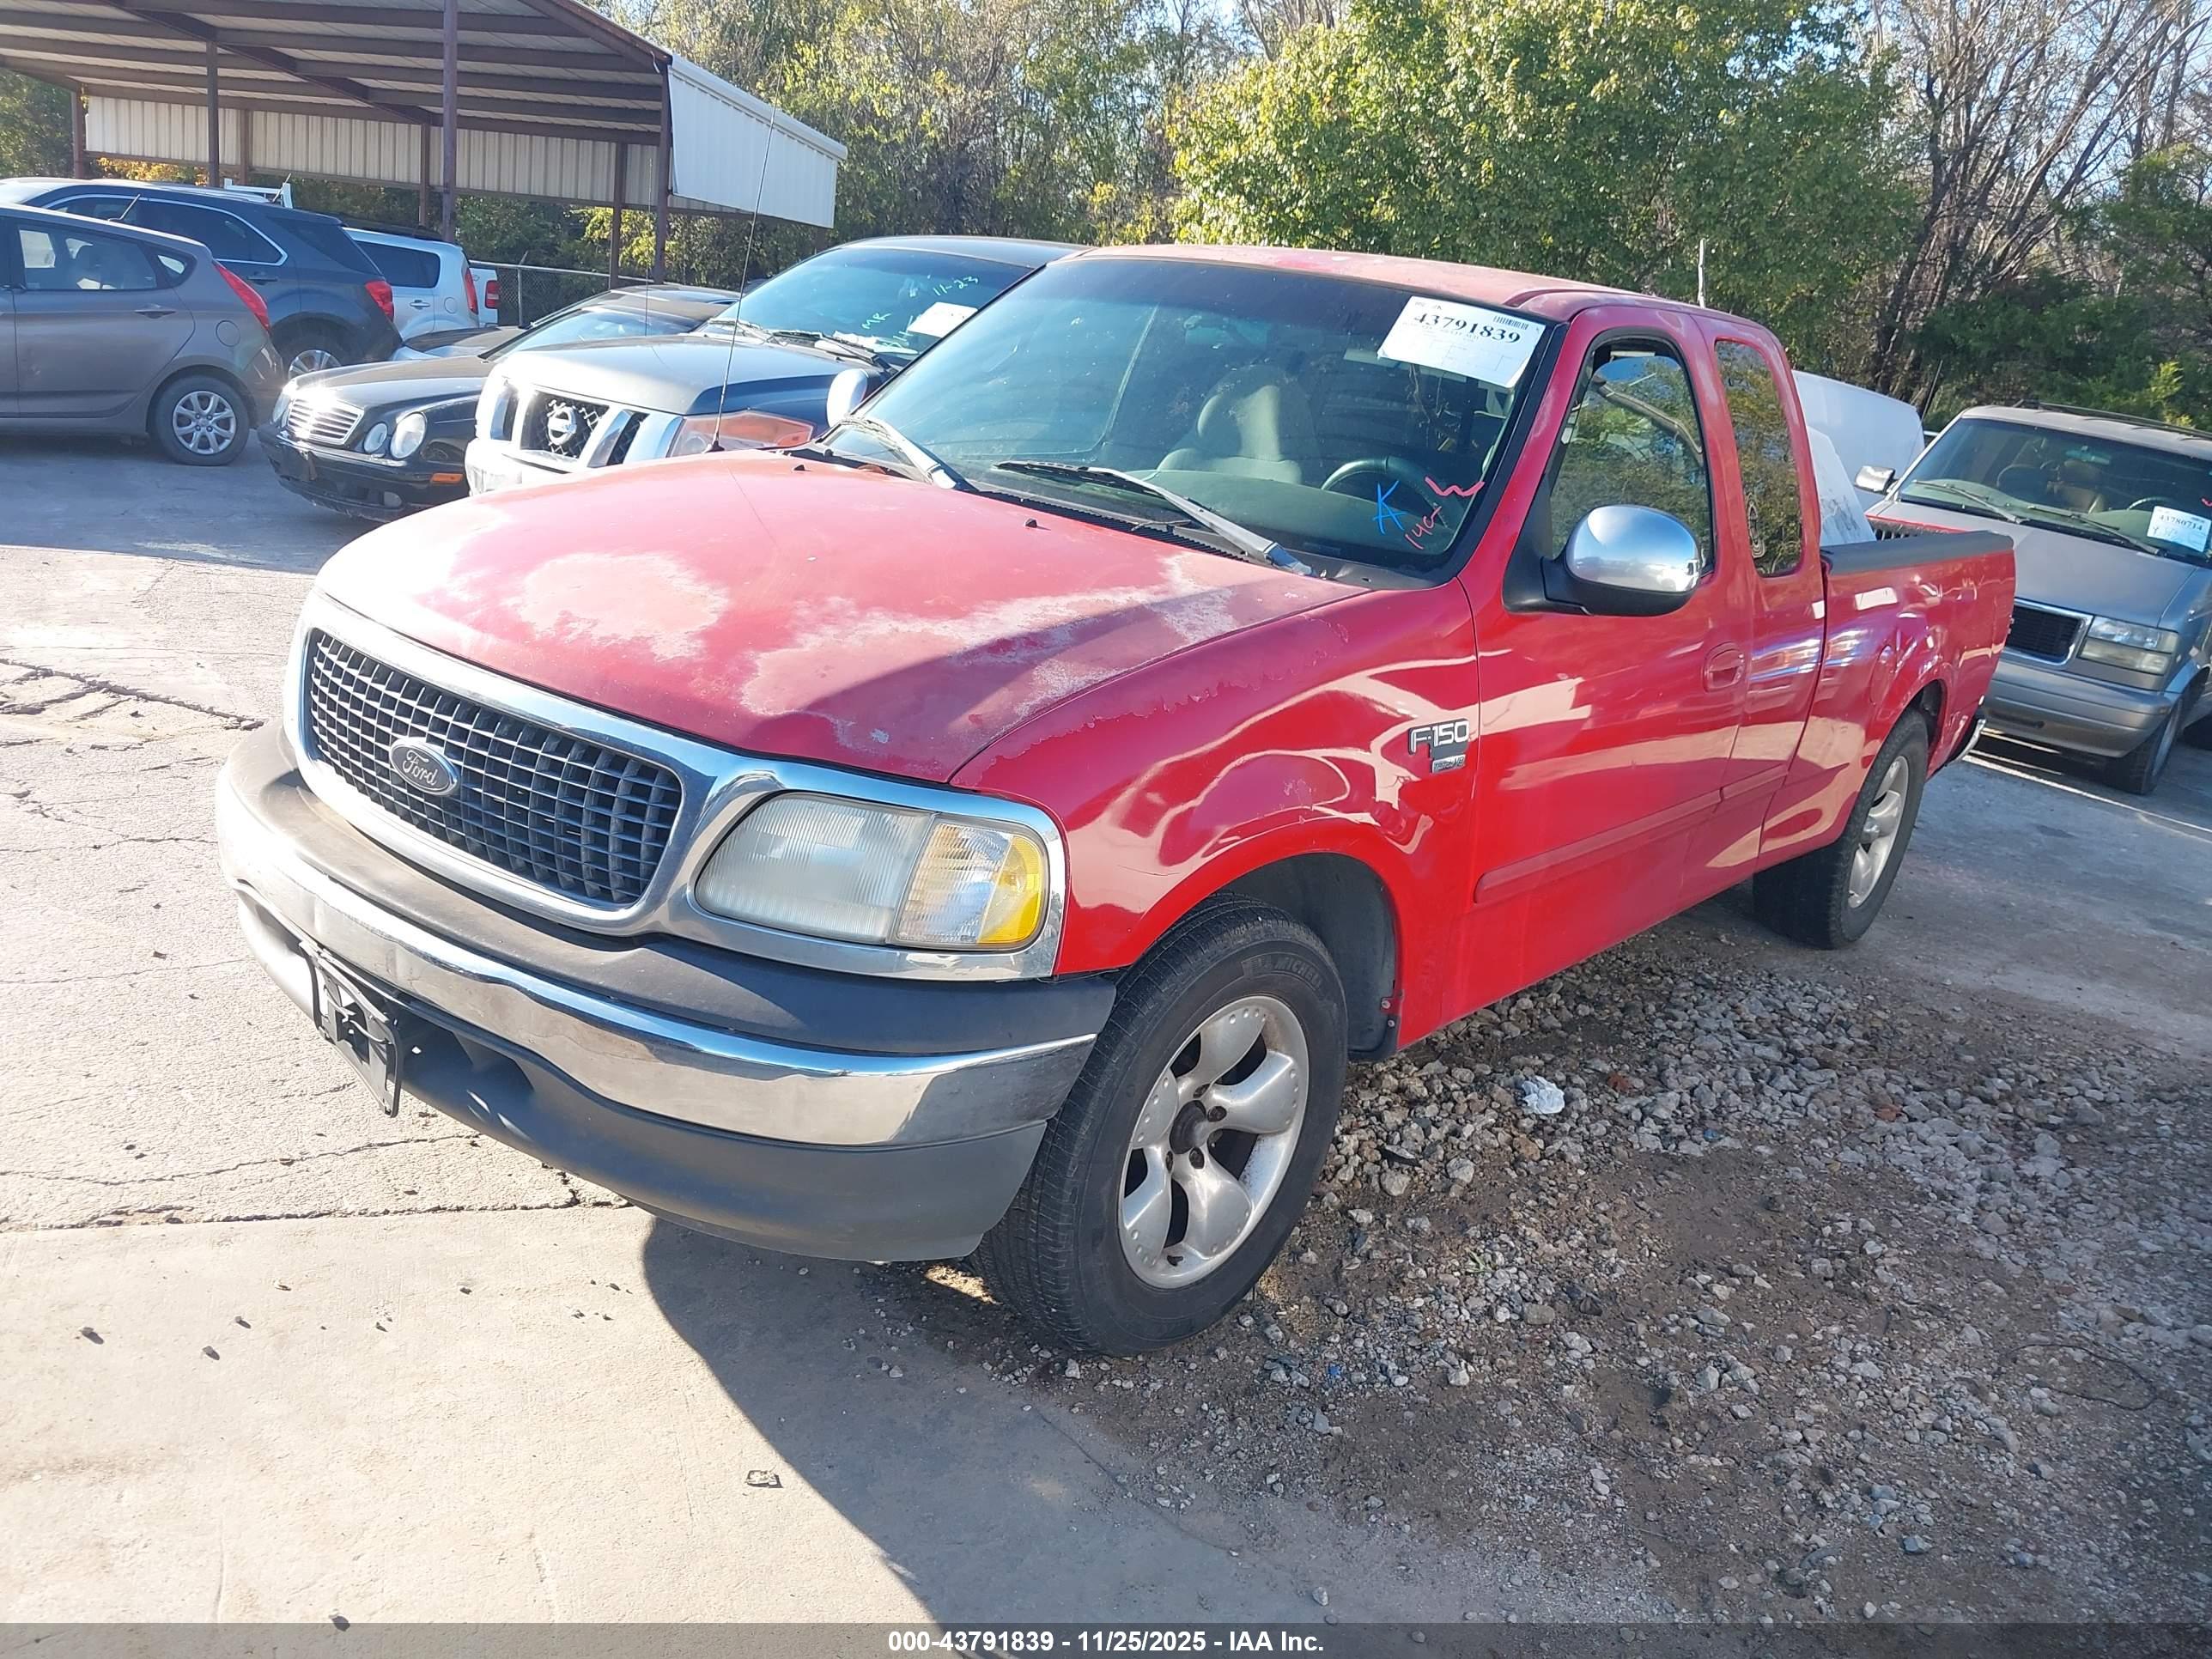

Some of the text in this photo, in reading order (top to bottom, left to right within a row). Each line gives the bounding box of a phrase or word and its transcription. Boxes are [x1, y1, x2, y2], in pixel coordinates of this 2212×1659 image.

[1414, 313, 1521, 343] 43791839
[1411, 720, 1470, 753] F-150
[403, 749, 439, 787] Ford
[1273, 957, 1325, 990] MICHEL
